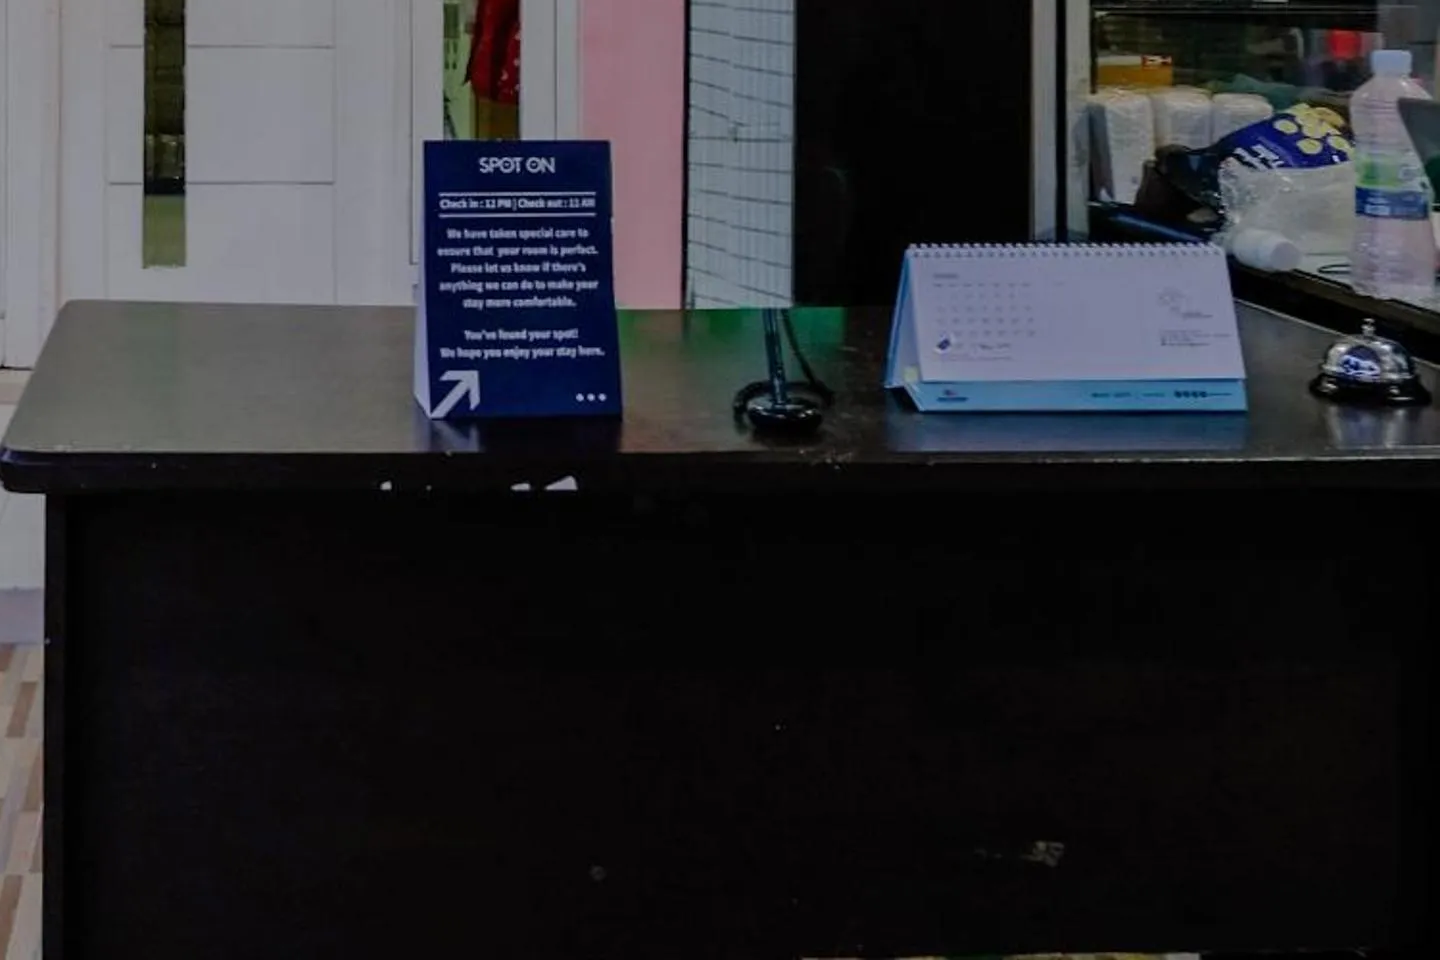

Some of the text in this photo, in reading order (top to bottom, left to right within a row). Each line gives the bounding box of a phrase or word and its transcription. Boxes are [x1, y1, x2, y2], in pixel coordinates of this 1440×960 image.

[479, 157, 555, 173] SPOT ON
[439, 198, 467, 210] Check
[497, 198, 512, 209] PM
[518, 197, 545, 209] Check
[581, 197, 595, 208] AM
[447, 227, 588, 241] We have taken special care to
[437, 243, 598, 258] ensure that your room is perfect.
[451, 261, 586, 274] Please let us know if there's
[440, 278, 598, 294] anything we can do to make your
[463, 295, 576, 311] stay more comfortable.
[464, 328, 578, 342] You've found your spot!
[440, 345, 604, 361] We hope you enjoy your stay here.
